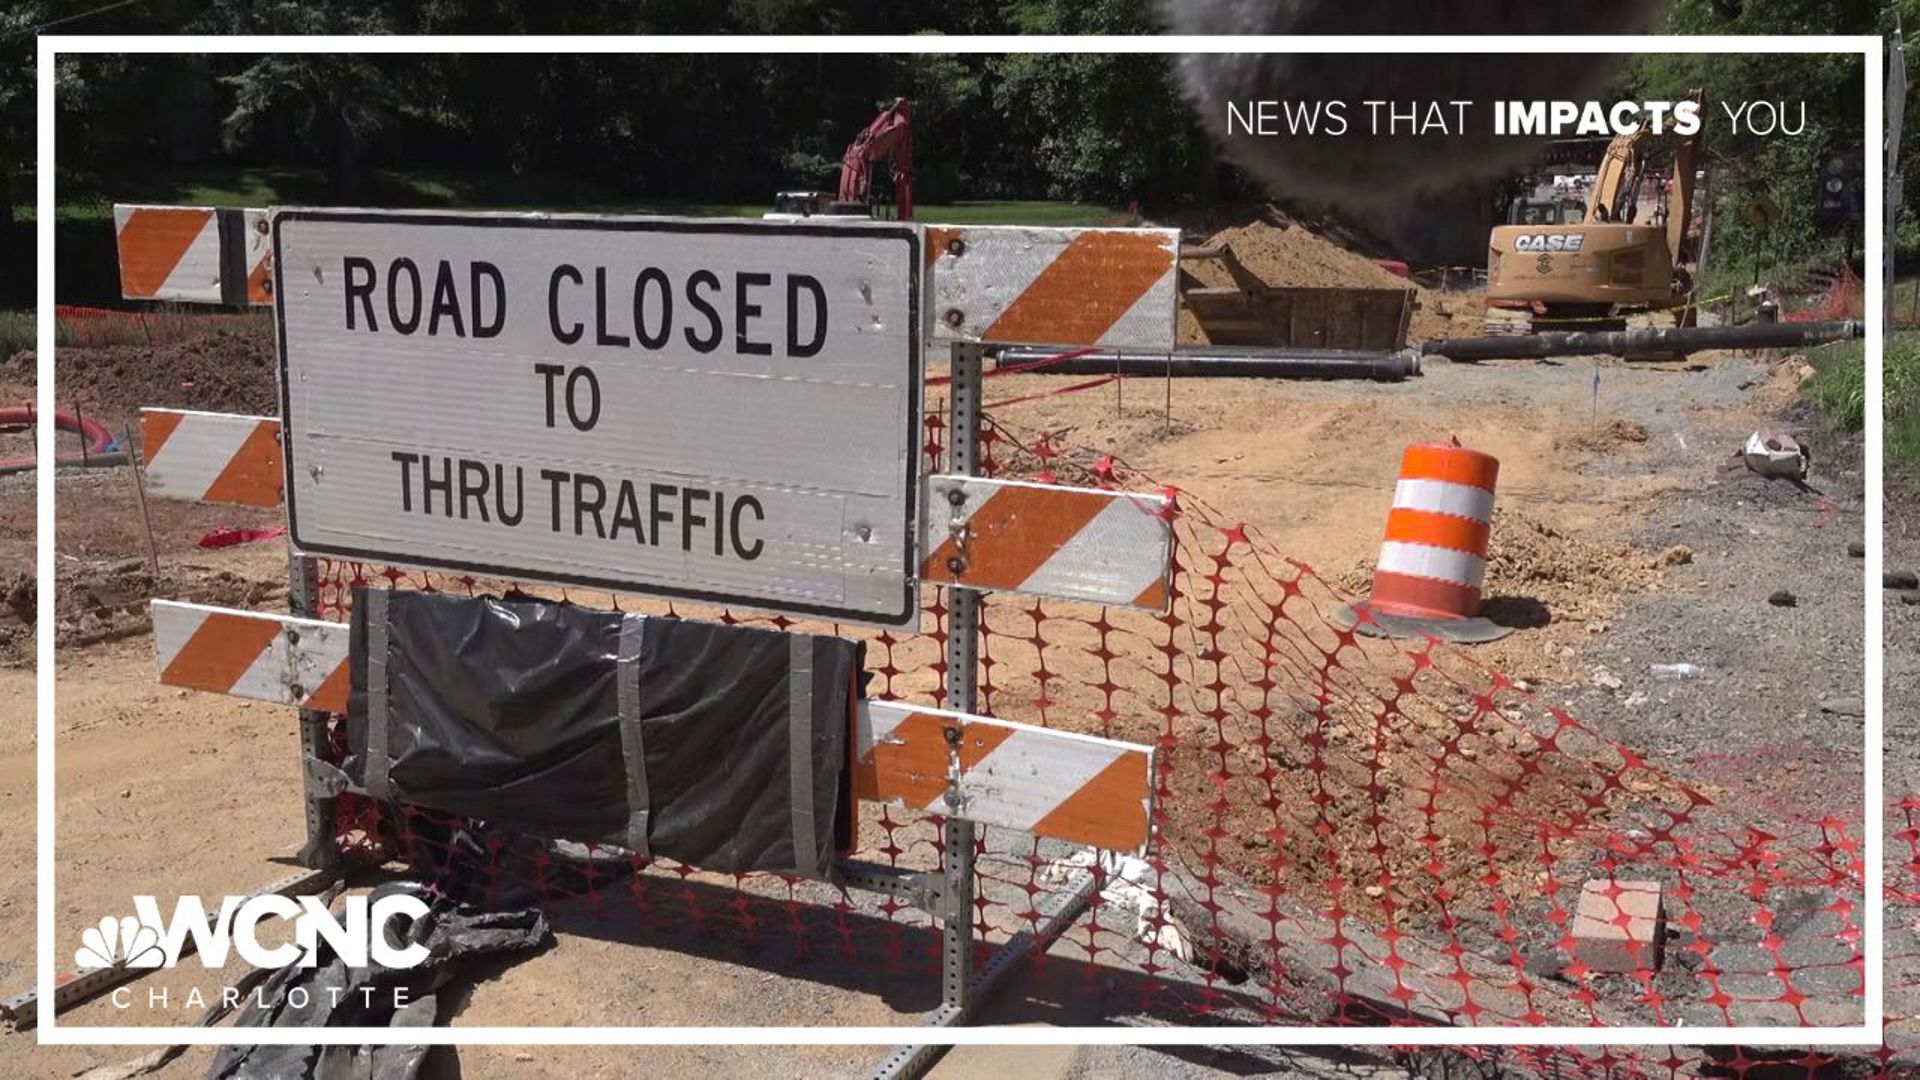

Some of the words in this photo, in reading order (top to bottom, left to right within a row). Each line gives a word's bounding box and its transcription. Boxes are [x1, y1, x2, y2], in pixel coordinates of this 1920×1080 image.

[1515, 234, 1584, 251] CASE
[343, 256, 507, 338] ROAD
[548, 264, 829, 359] CLOSED
[534, 363, 602, 432] TO
[391, 451, 524, 527] THRU
[540, 468, 765, 561] TRAFFIC
